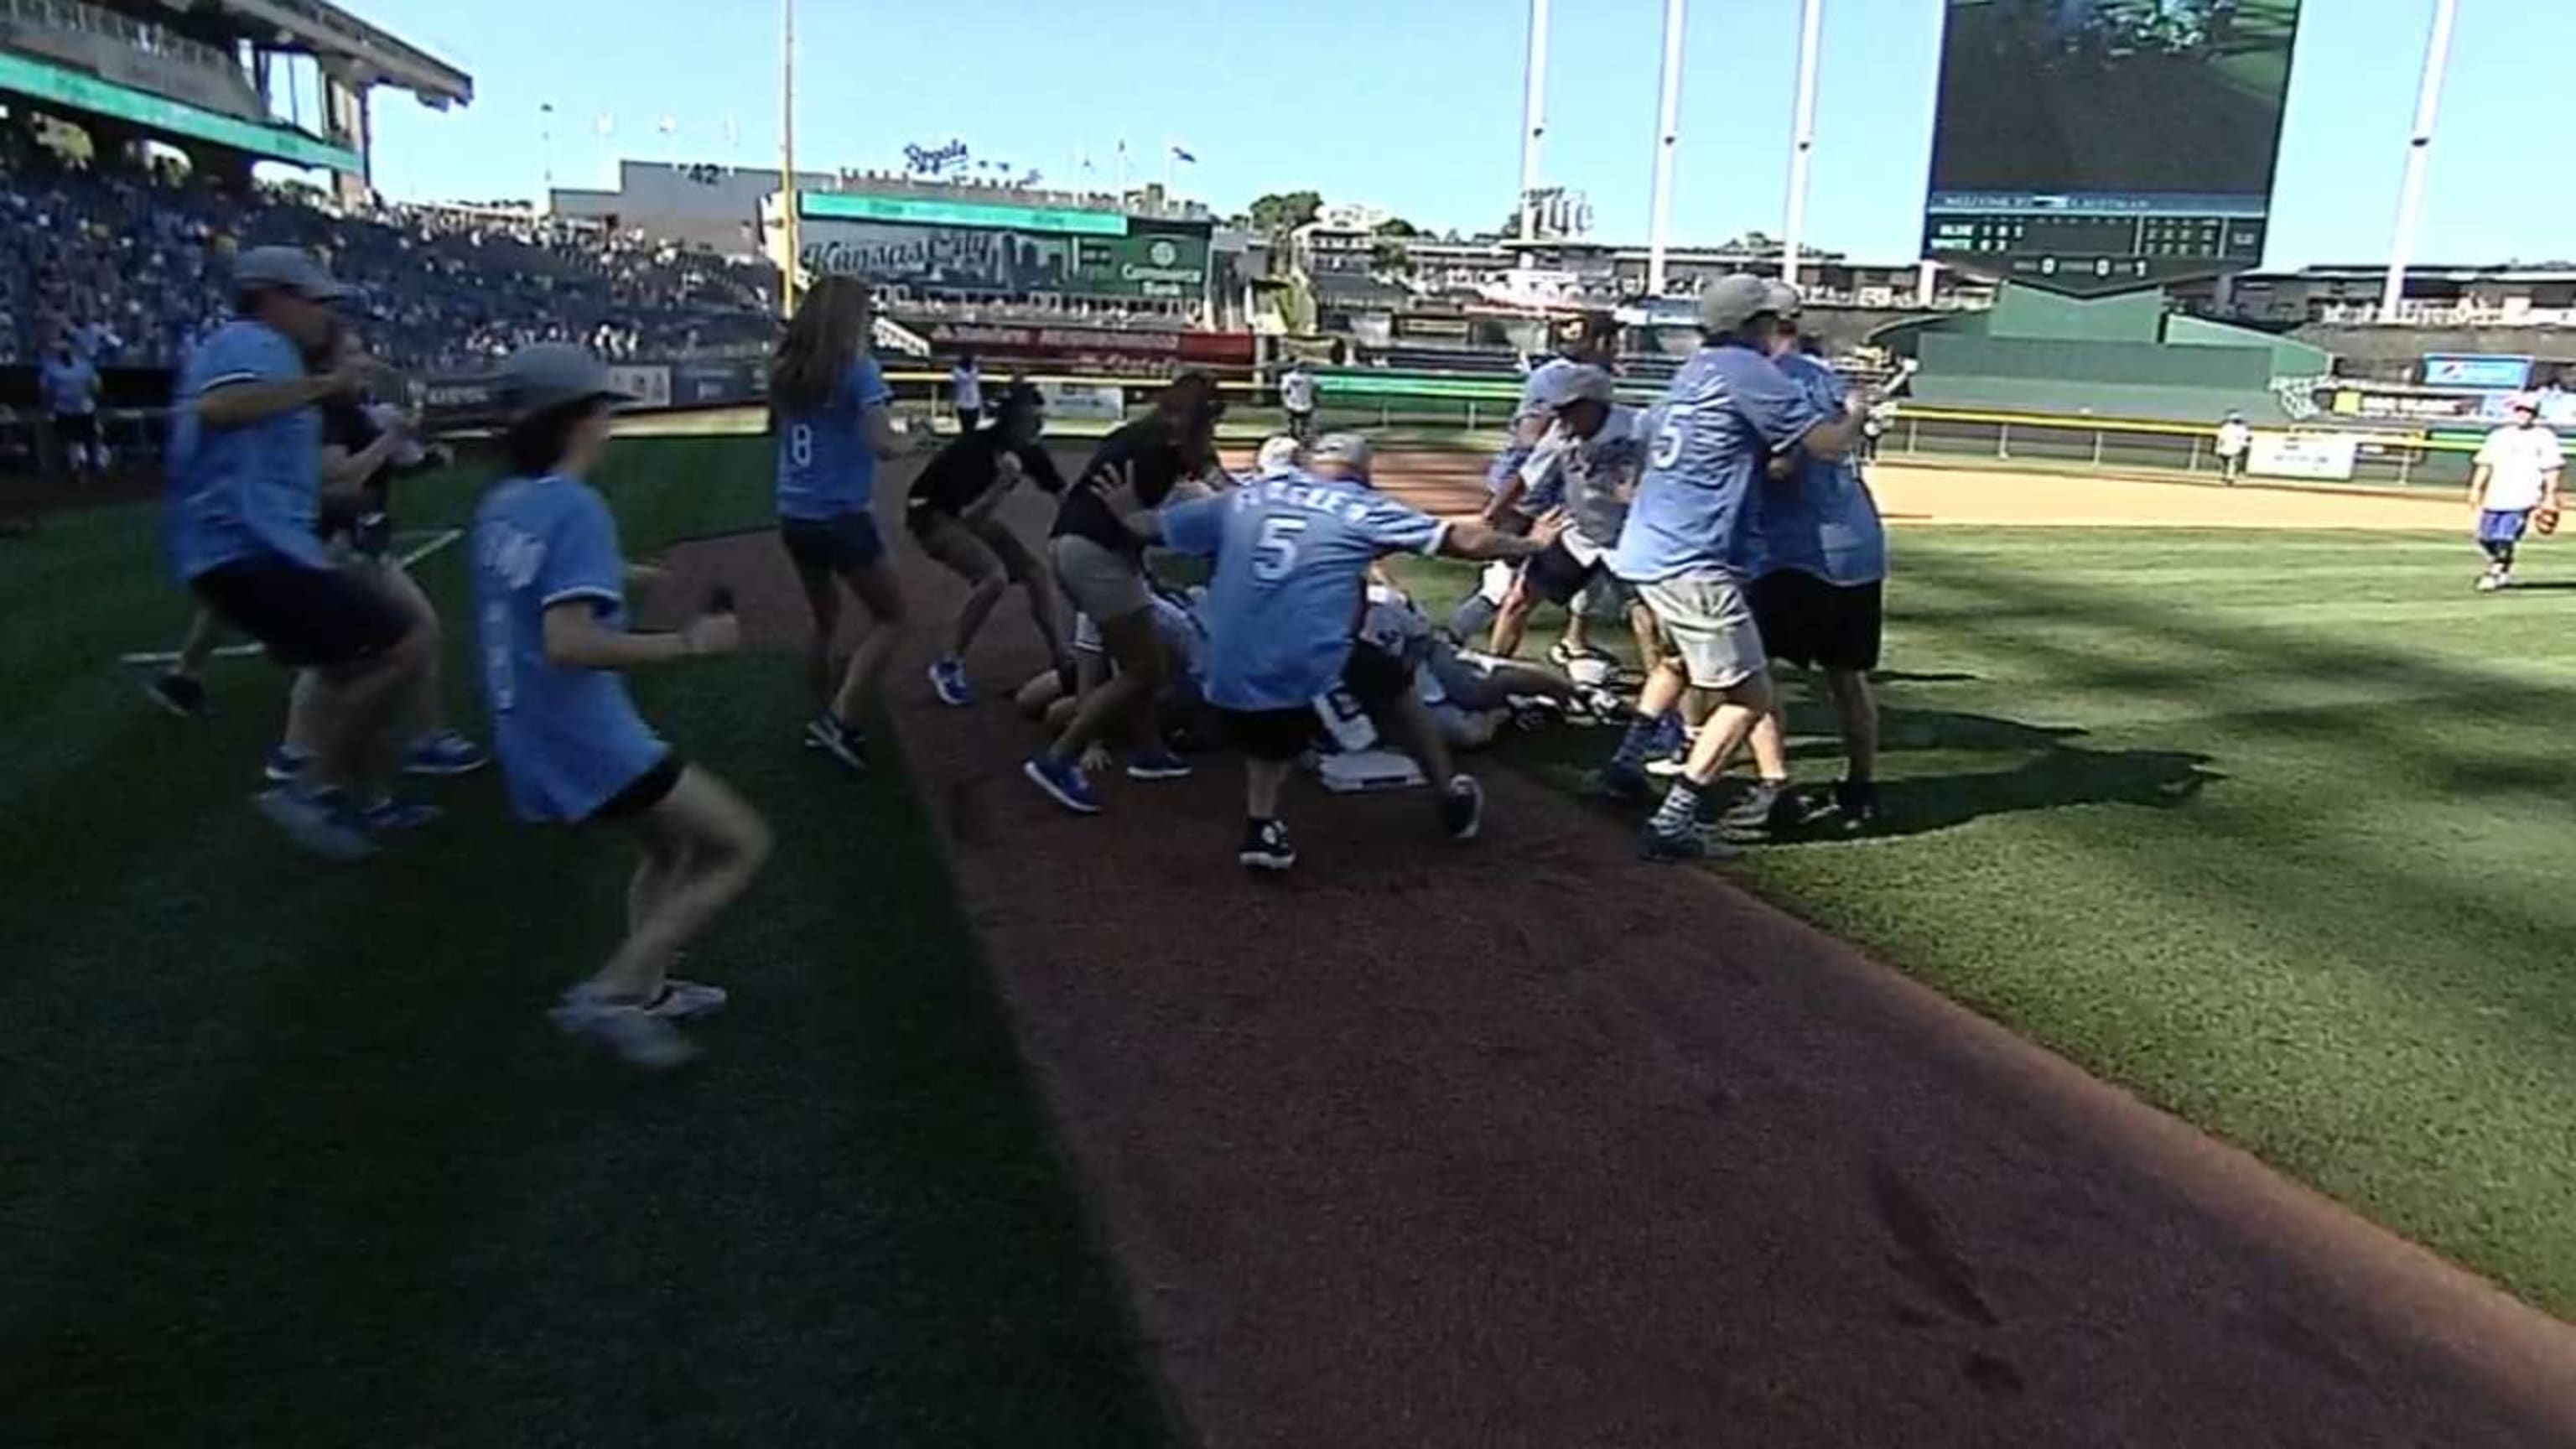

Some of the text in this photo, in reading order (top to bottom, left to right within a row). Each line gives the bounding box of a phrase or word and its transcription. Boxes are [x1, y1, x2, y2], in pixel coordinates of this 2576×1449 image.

[802, 240, 926, 277] Kansas
[792, 423, 812, 467] 8
[1649, 404, 1695, 468] 5
[1253, 517, 1308, 581] 5
